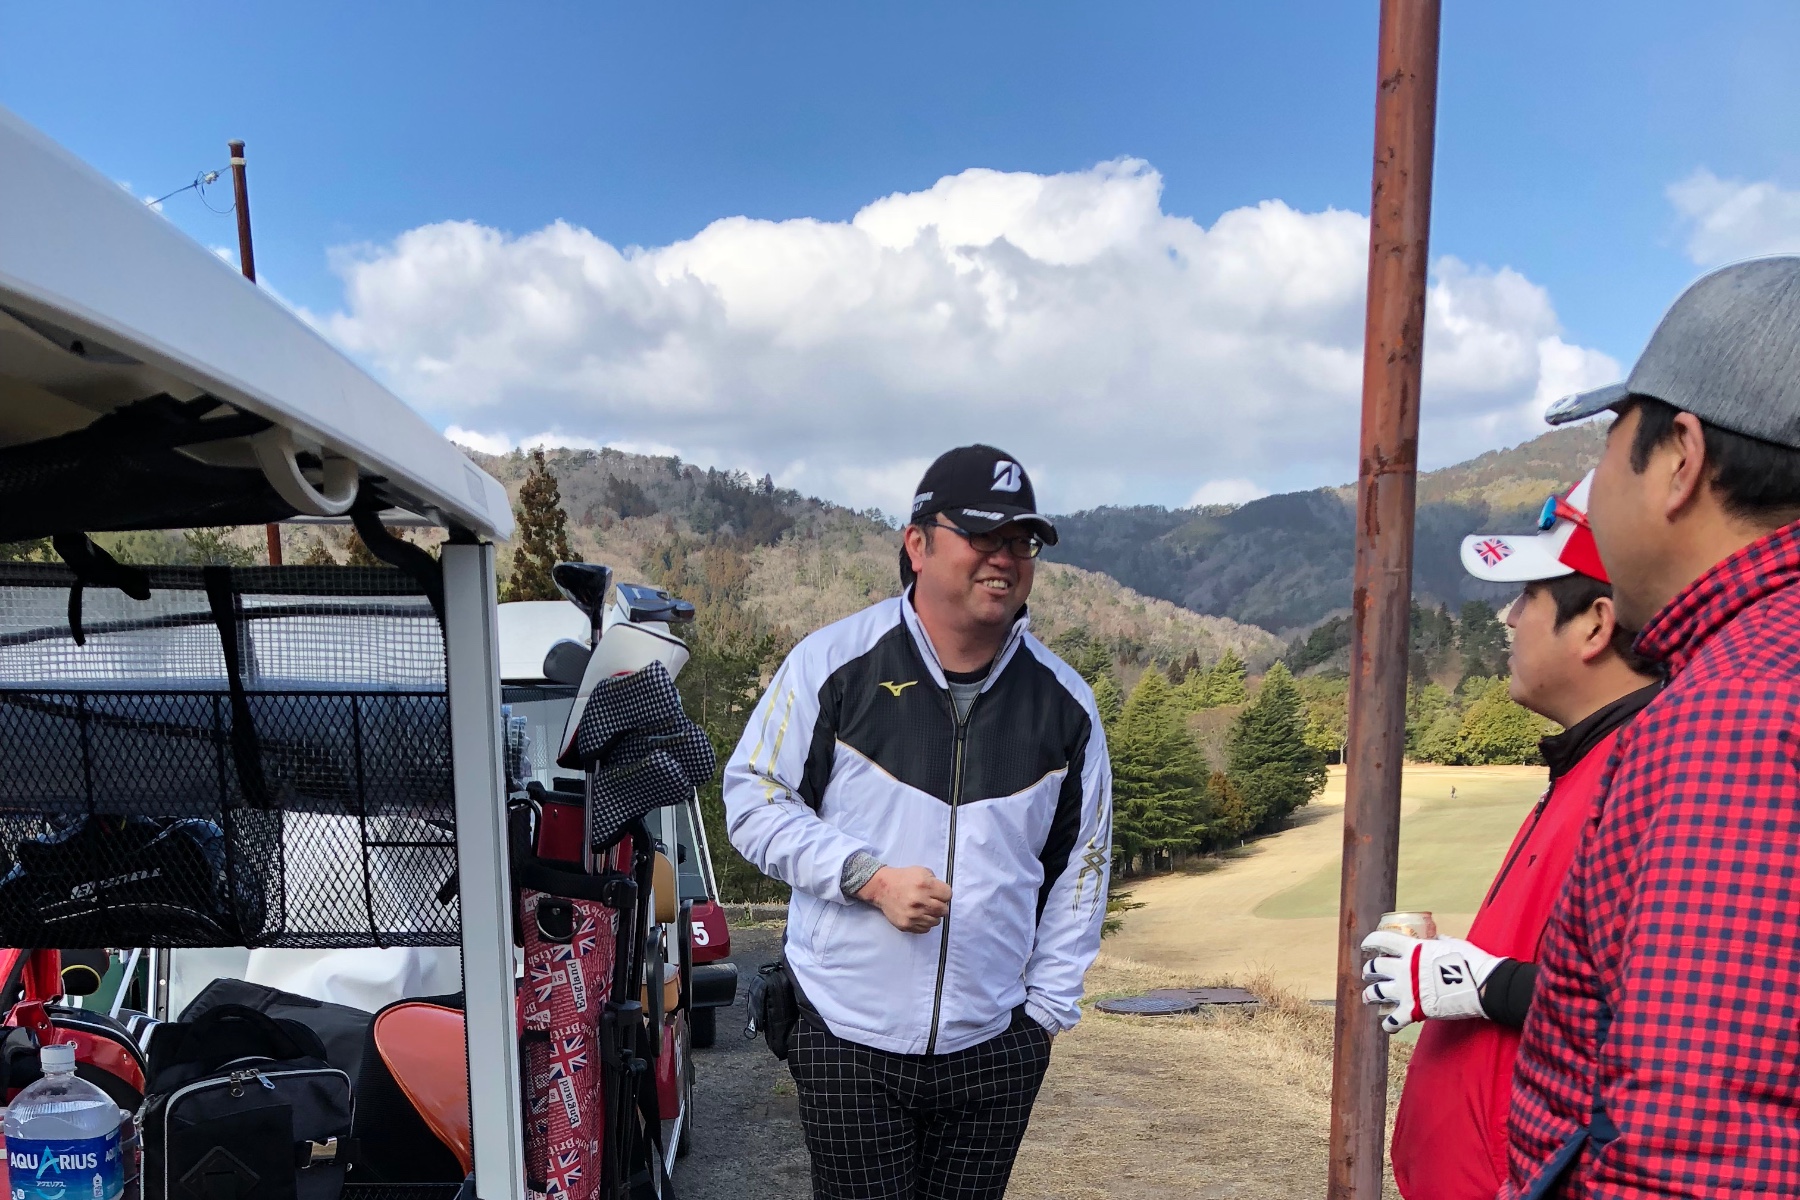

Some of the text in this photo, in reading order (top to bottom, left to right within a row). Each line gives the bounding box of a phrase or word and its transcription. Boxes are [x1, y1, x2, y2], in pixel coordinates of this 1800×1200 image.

[692, 922, 710, 946] 5
[567, 961, 585, 1009] England
[560, 1079, 579, 1124] England
[11, 1145, 98, 1179] AQUARIUS
[548, 1137, 575, 1156] Brit
